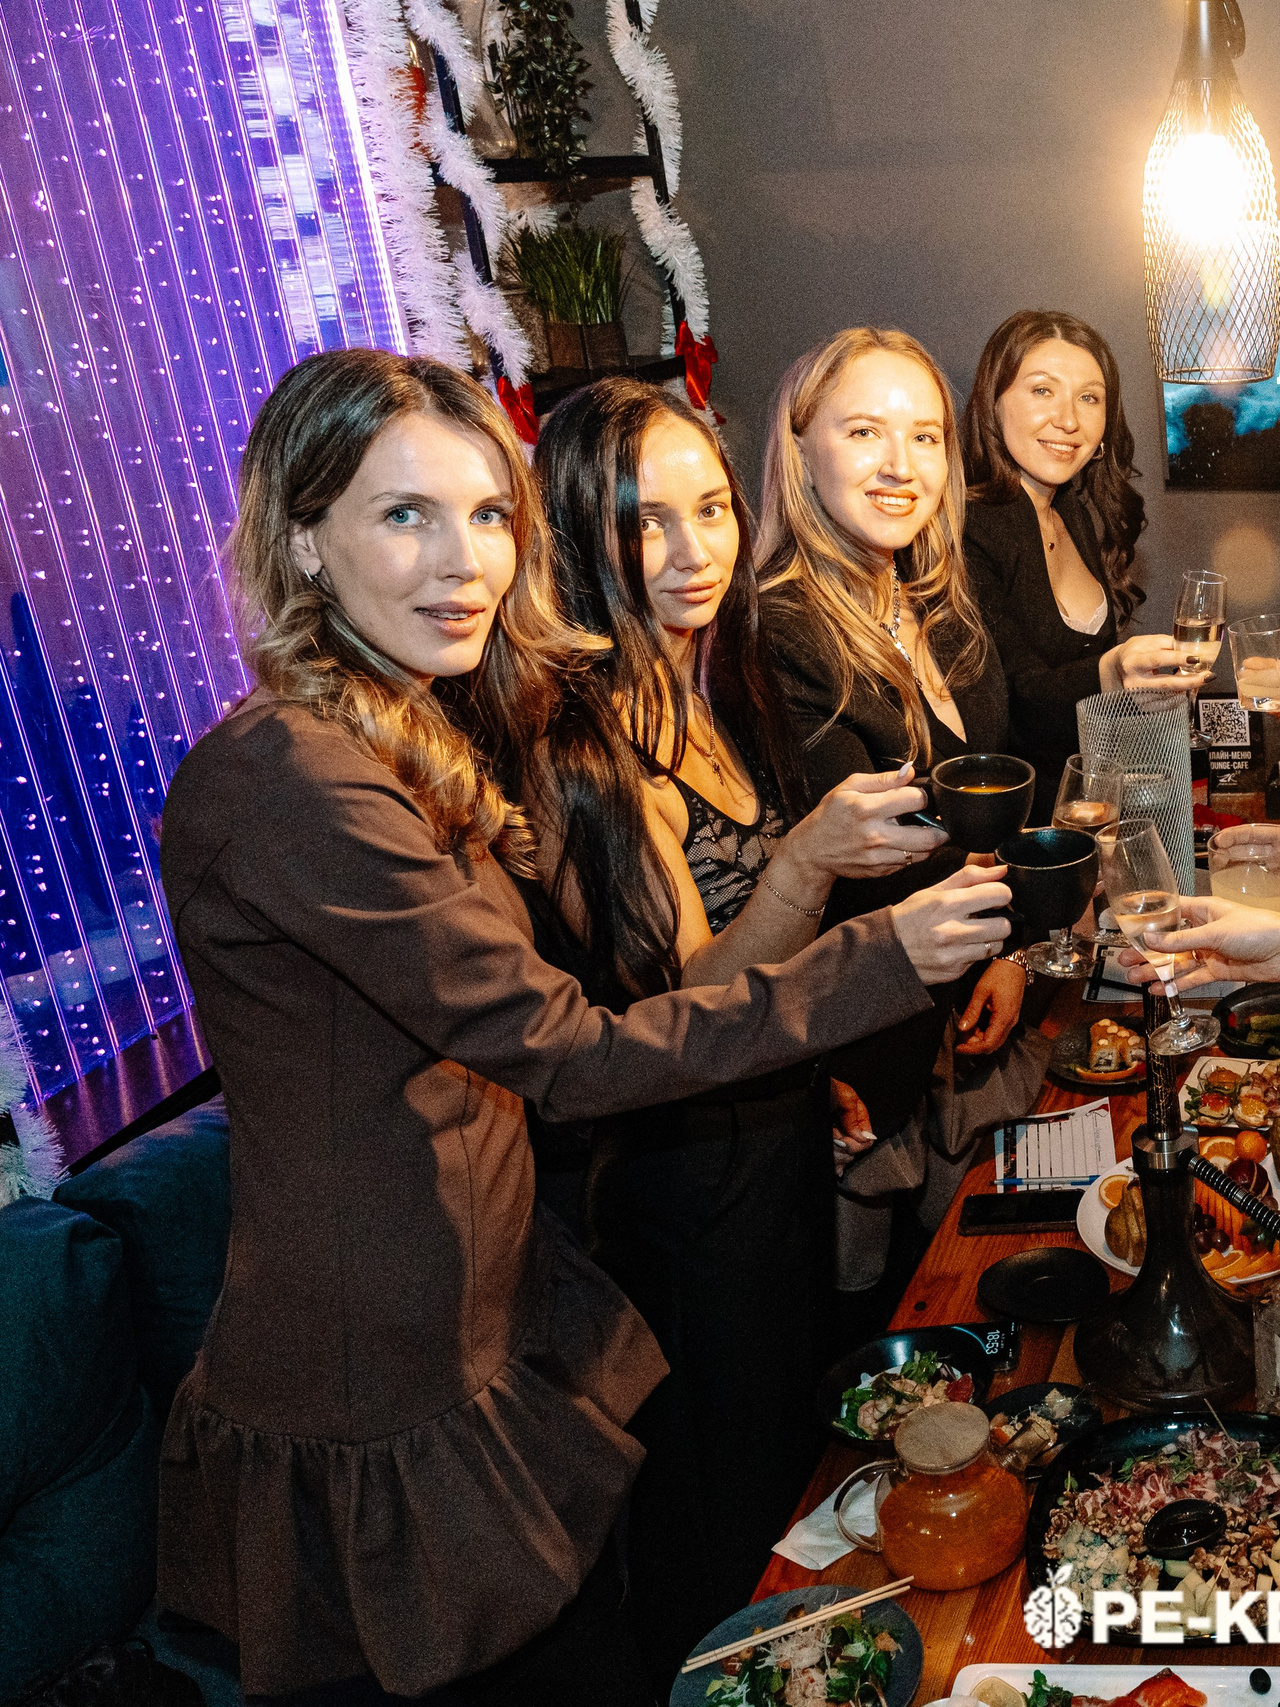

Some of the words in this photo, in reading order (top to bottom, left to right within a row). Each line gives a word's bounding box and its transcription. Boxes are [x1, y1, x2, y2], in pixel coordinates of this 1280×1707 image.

[1209, 750, 1252, 760] ЛАЙН-МЕНЮ
[1210, 761, 1250, 770] OUNGE-CAFE
[985, 1329, 1001, 1355] 18:53
